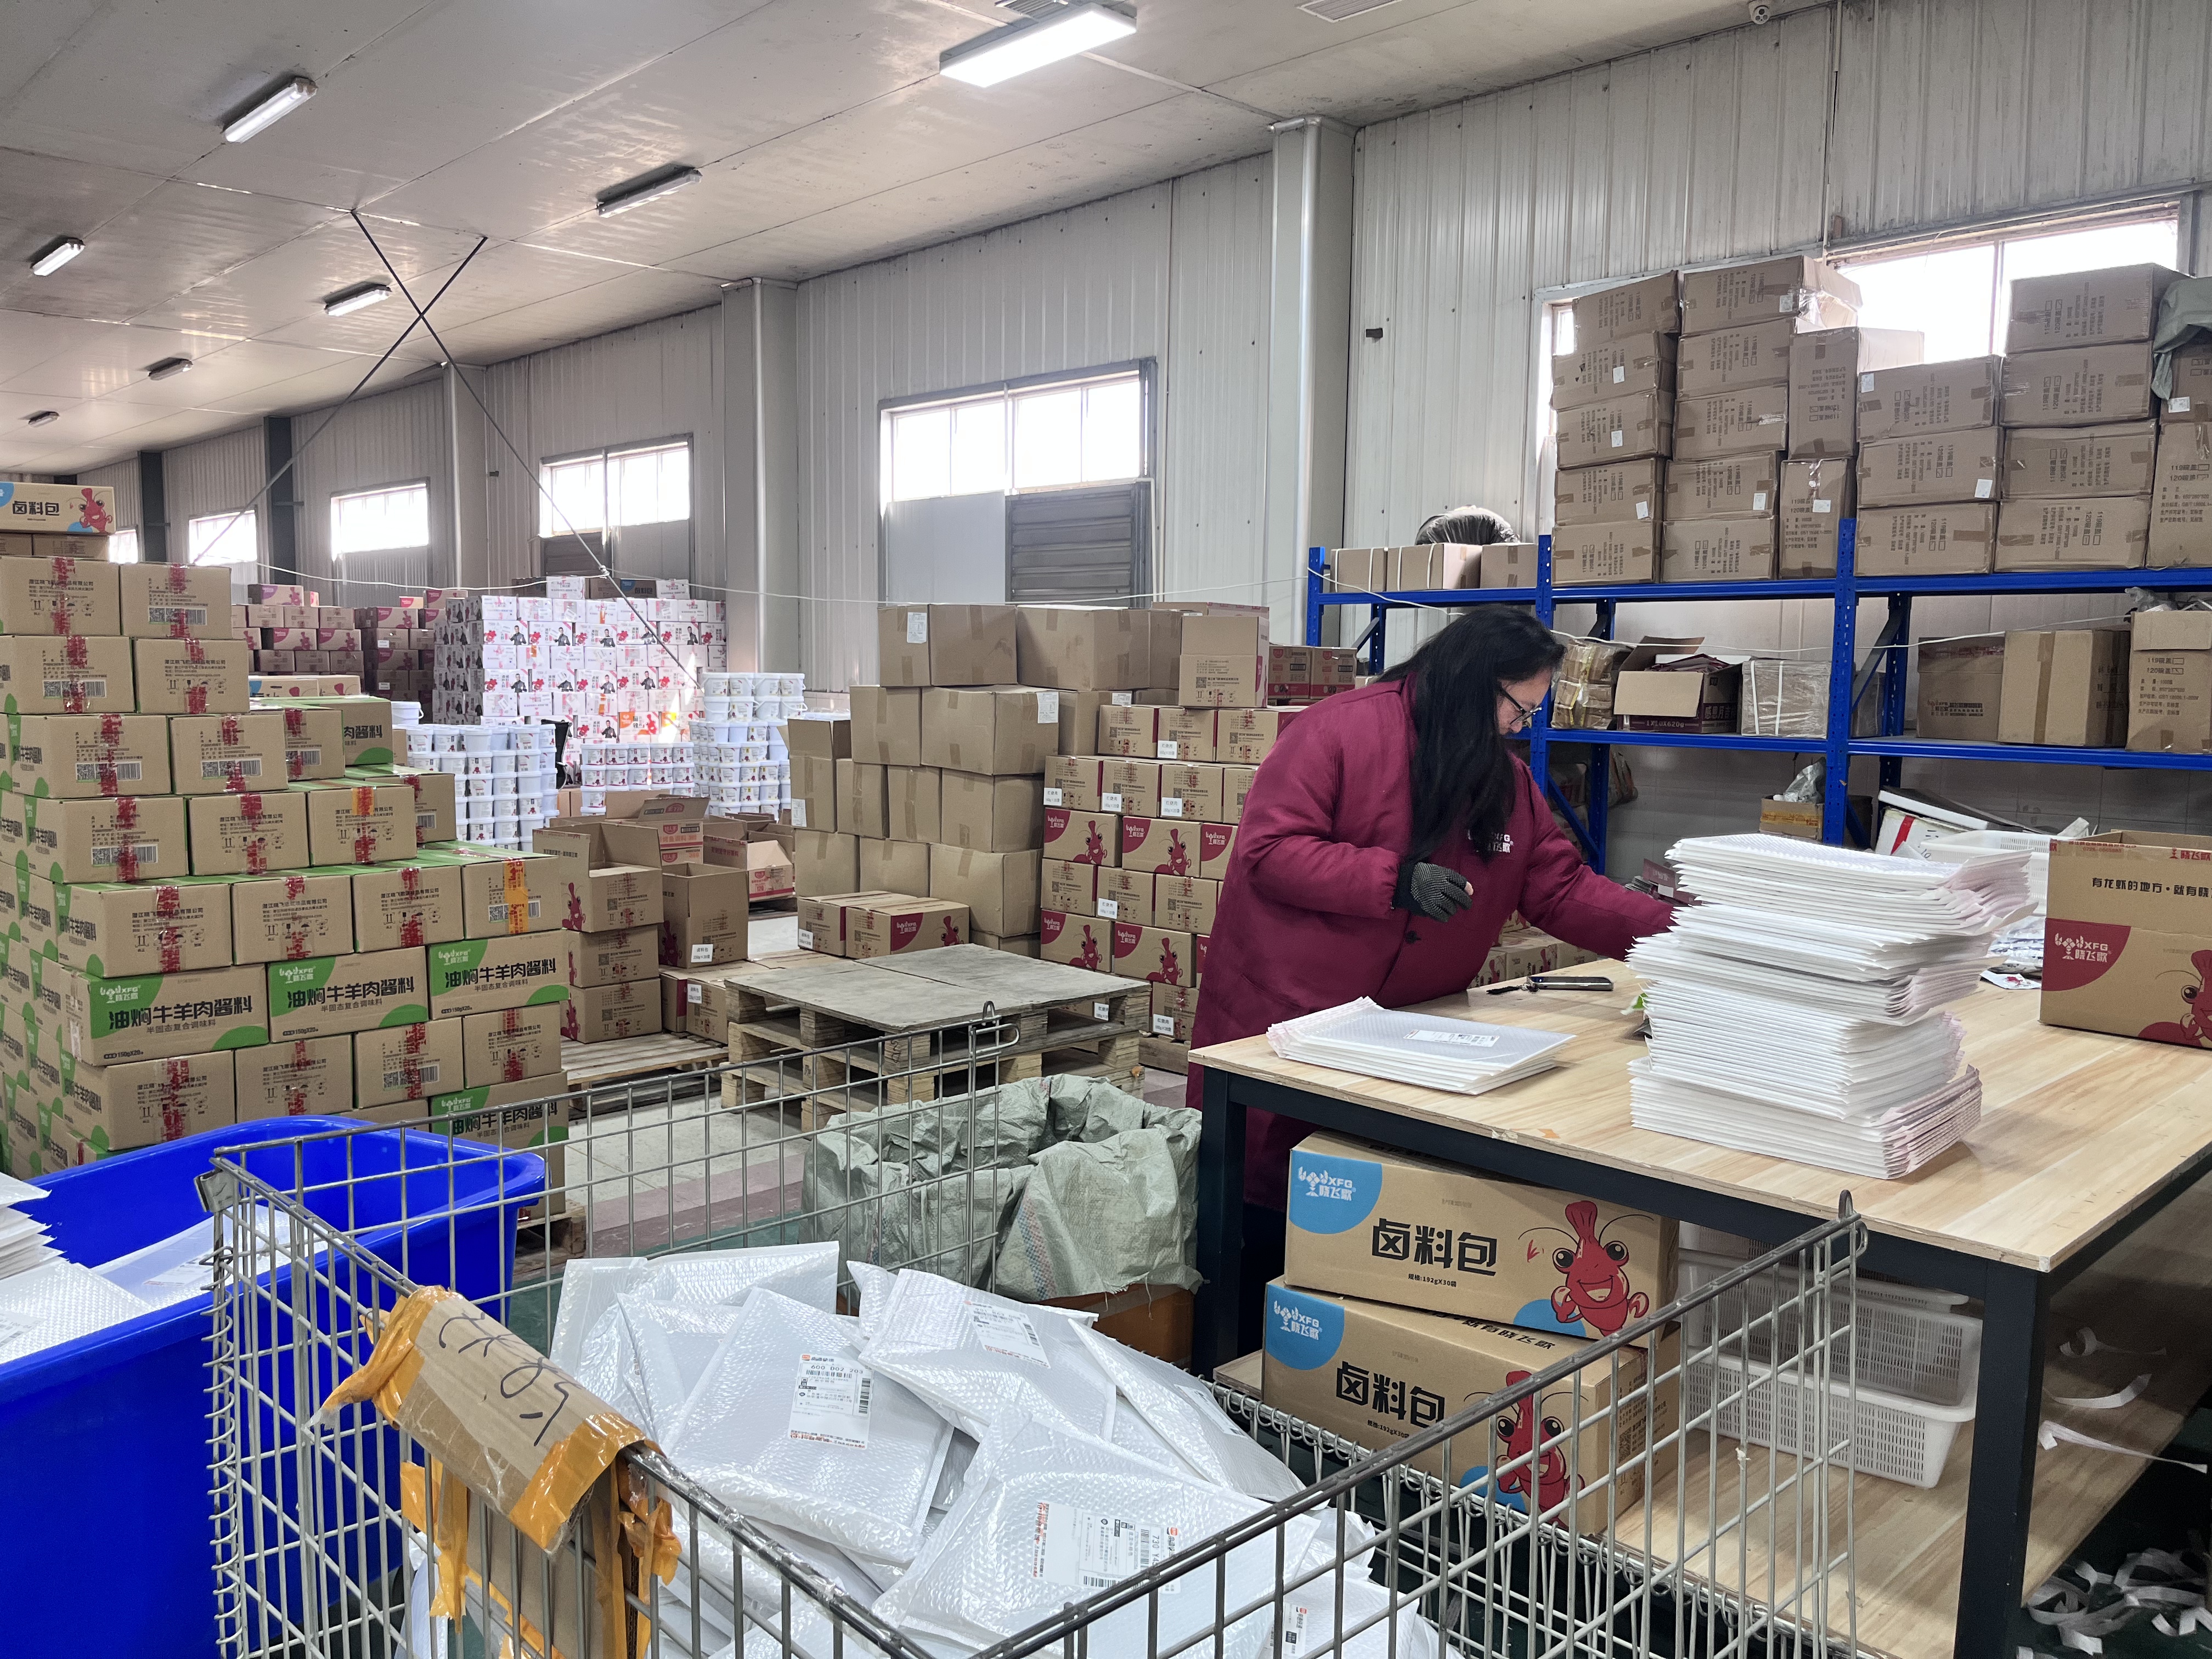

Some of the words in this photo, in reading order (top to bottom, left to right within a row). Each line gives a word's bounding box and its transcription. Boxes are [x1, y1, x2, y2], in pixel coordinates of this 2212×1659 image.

[12, 501, 59, 516] 卤料包
[344, 725, 383, 739] 肉酱料
[2180, 850, 2211, 861] 晓飞歌
[2092, 877, 2212, 898] 有龙虾的地方·就有晓
[2084, 941, 2108, 951] XFG
[2074, 949, 2108, 963] 晓飞歌
[445, 958, 556, 988] 油焖牛羊肉酱料
[287, 977, 415, 1008] 油焖牛羊肉酱料
[475, 979, 528, 992] 半固态复合调味料
[321, 998, 383, 1012] 半固态复合调味料
[109, 996, 252, 1030] 油焖牛羊肉酱料
[147, 1019, 216, 1034] 半固态复合调味料
[1328, 1179, 1353, 1188] XFG
[1319, 1186, 1352, 1201] 晓飞歌
[1372, 1218, 1498, 1276] 卤料包
[1299, 1316, 1319, 1327] XFG
[1290, 1321, 1320, 1340] 晓飞歌
[1336, 1361, 1445, 1427] 卤料包
